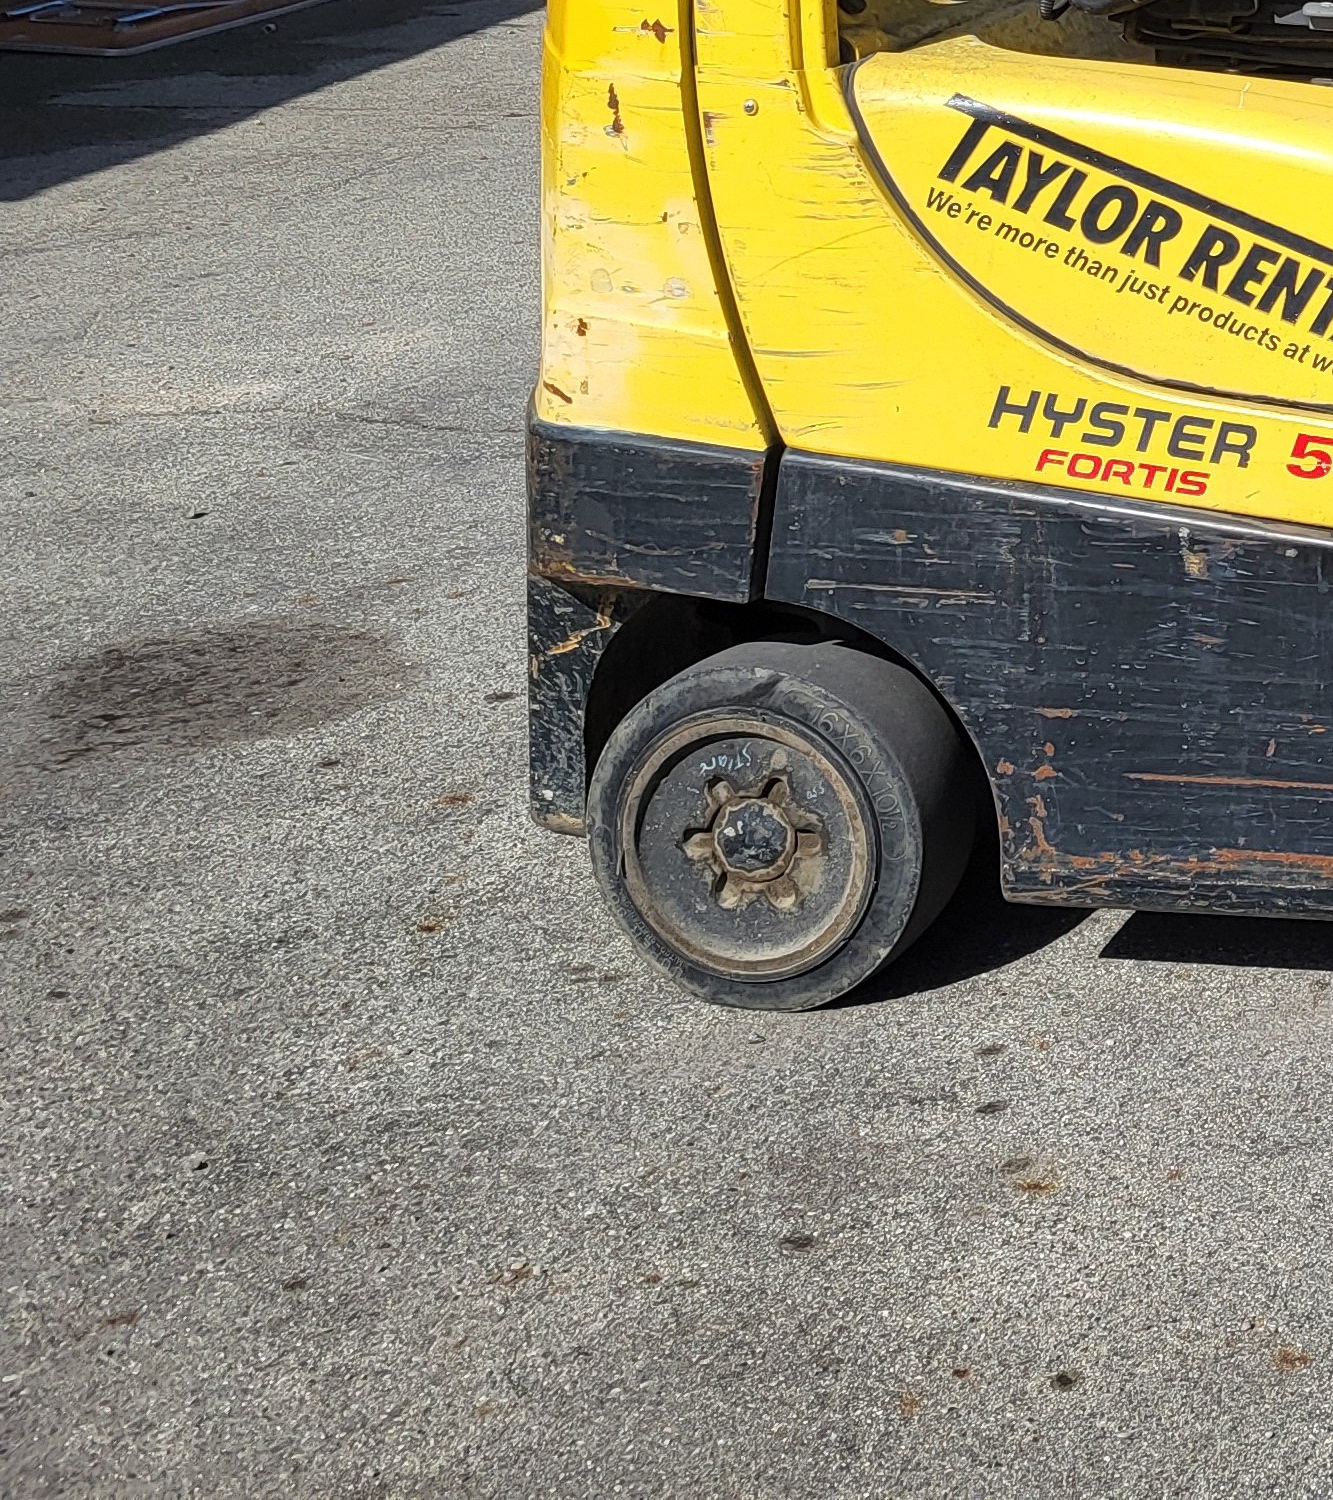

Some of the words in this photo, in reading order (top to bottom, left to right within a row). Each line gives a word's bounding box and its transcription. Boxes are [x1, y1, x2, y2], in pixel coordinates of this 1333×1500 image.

[937, 93, 1183, 271] TAYLOR
[925, 187, 992, 232] We're
[995, 218, 1061, 260] more
[1065, 245, 1118, 287] than
[1116, 269, 1171, 307] just
[1169, 294, 1281, 352] products
[1282, 341, 1311, 365] at
[987, 385, 1258, 469] HYSTER
[1035, 448, 1211, 497] FORTIS
